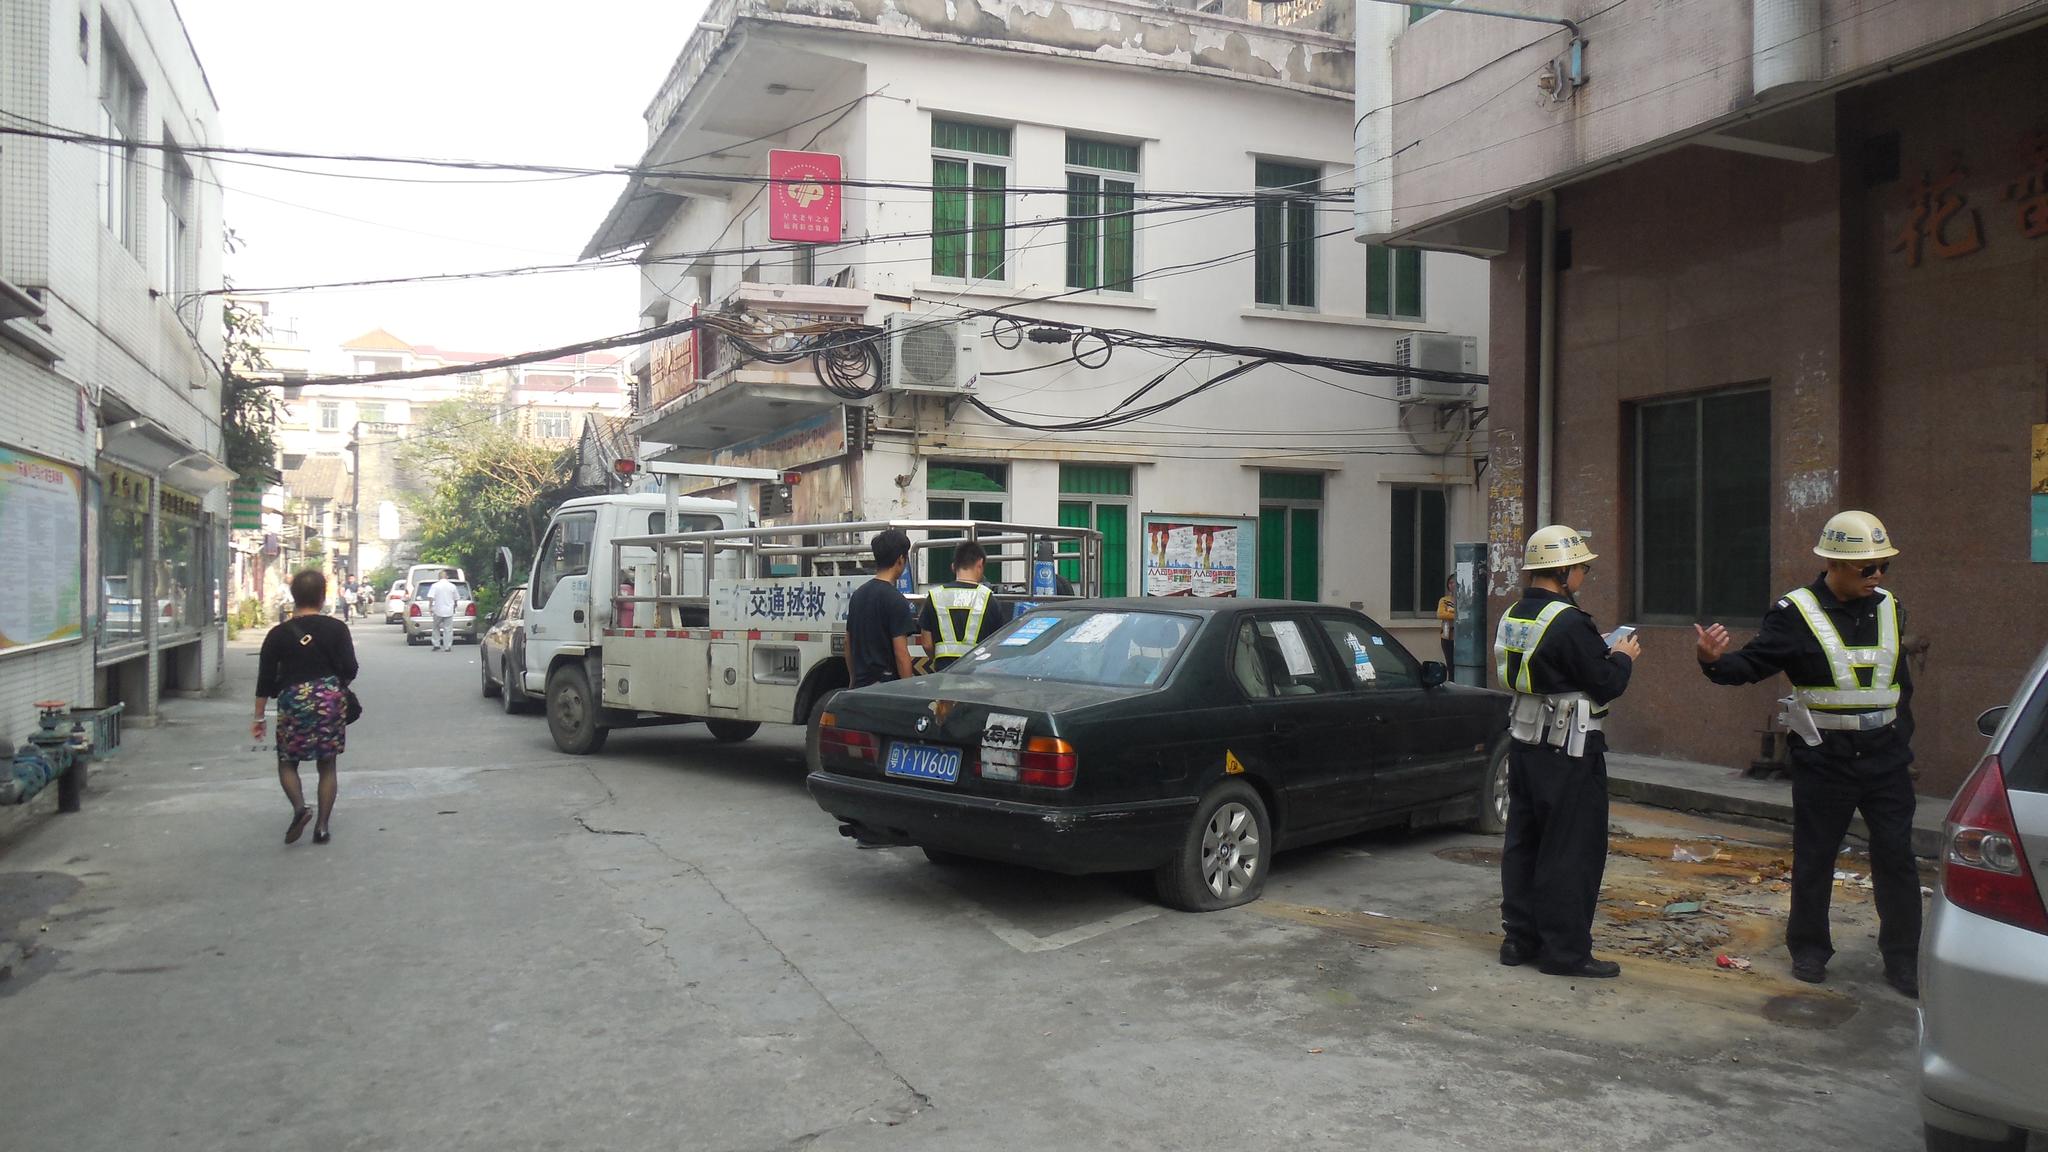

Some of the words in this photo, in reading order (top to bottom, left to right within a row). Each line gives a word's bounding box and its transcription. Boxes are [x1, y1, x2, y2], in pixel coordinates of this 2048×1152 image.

[1827, 529, 1846, 542] 警察
[750, 582, 826, 617] 交通拯救
